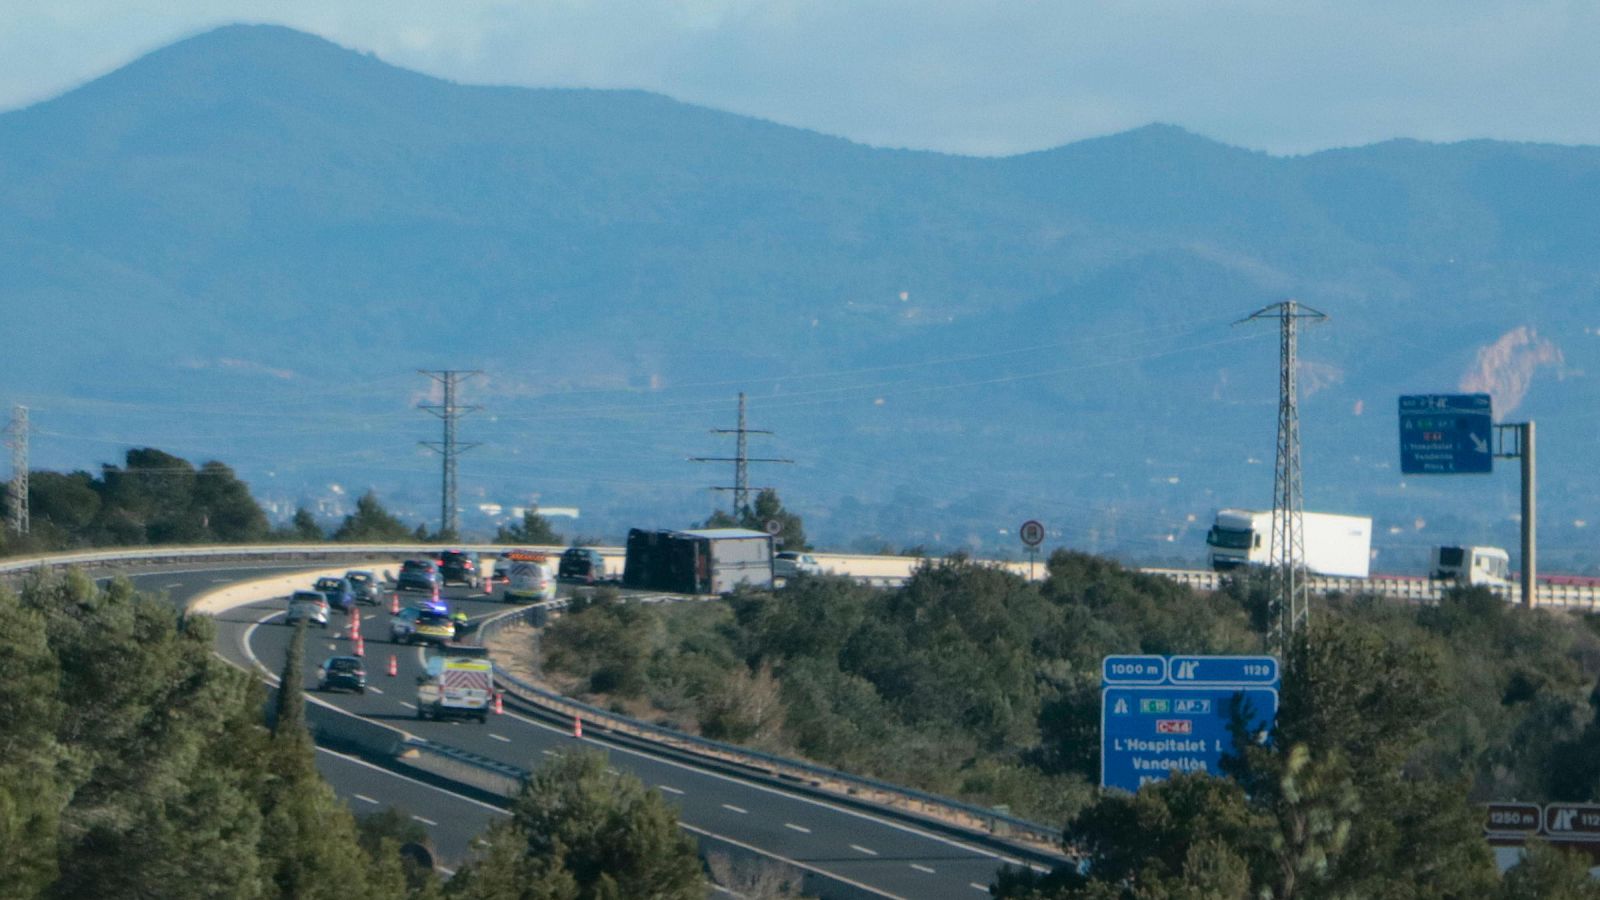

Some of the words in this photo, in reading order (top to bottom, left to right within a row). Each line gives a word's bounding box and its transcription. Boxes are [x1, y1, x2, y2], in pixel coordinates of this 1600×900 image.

[1111, 664, 1143, 675] 1000
[1146, 666, 1159, 675] m
[1176, 700, 1209, 712] AP-7
[1114, 739, 1206, 754] L'Hospitalet
[1491, 813, 1520, 824] 1250
[1522, 815, 1534, 824] m
